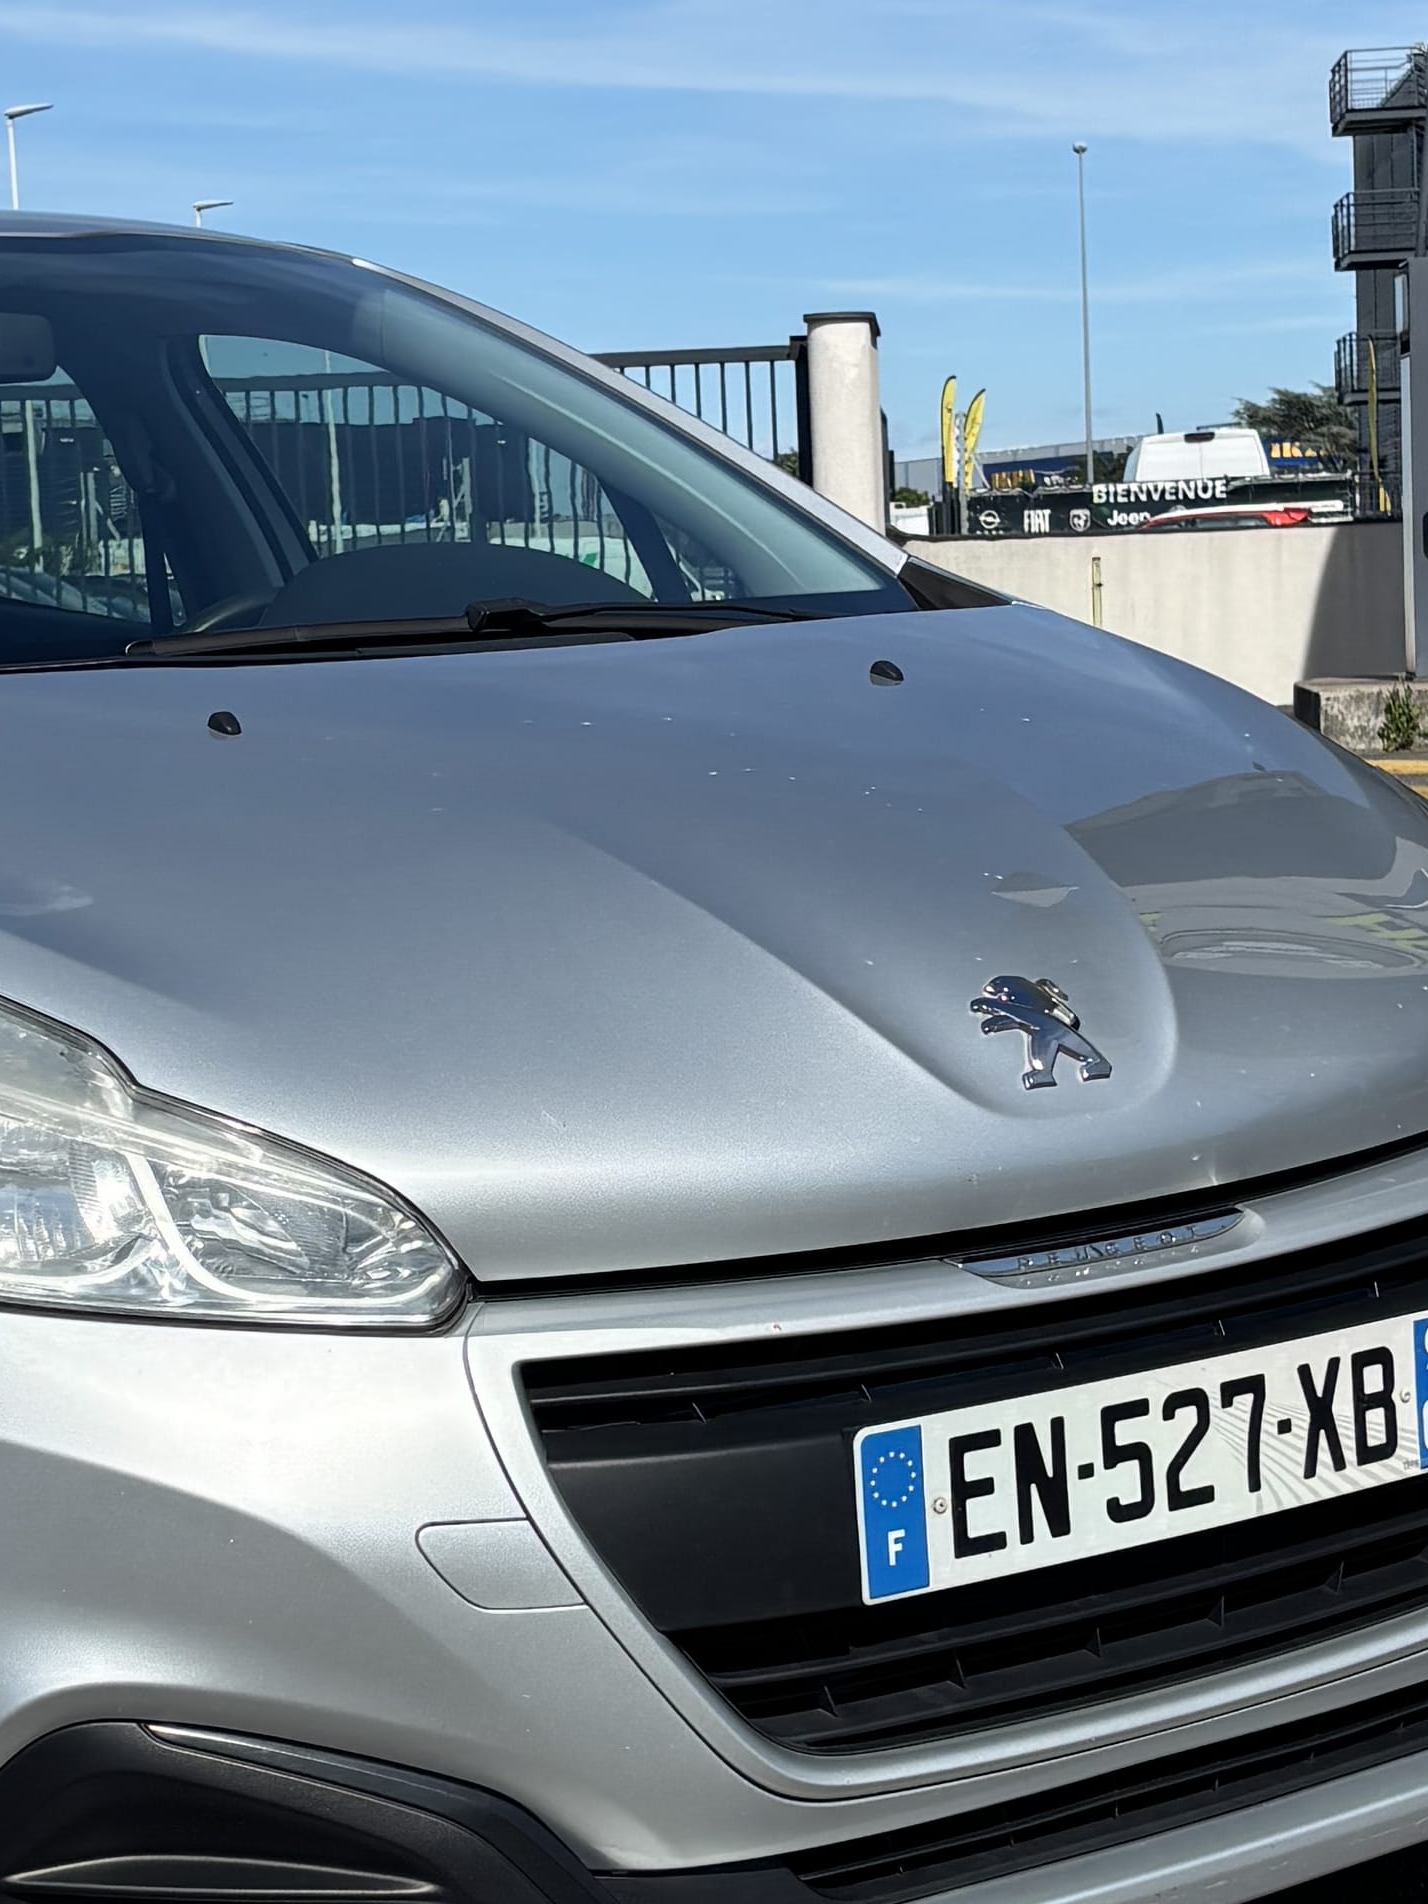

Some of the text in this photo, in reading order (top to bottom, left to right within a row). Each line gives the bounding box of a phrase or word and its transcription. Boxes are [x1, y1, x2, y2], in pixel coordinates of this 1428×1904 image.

[1092, 479, 1228, 504] BIENVENUE
[1023, 508, 1051, 533] FIAT
[948, 1346, 1399, 1559] EN-527-XB
[887, 1529, 906, 1567] F
